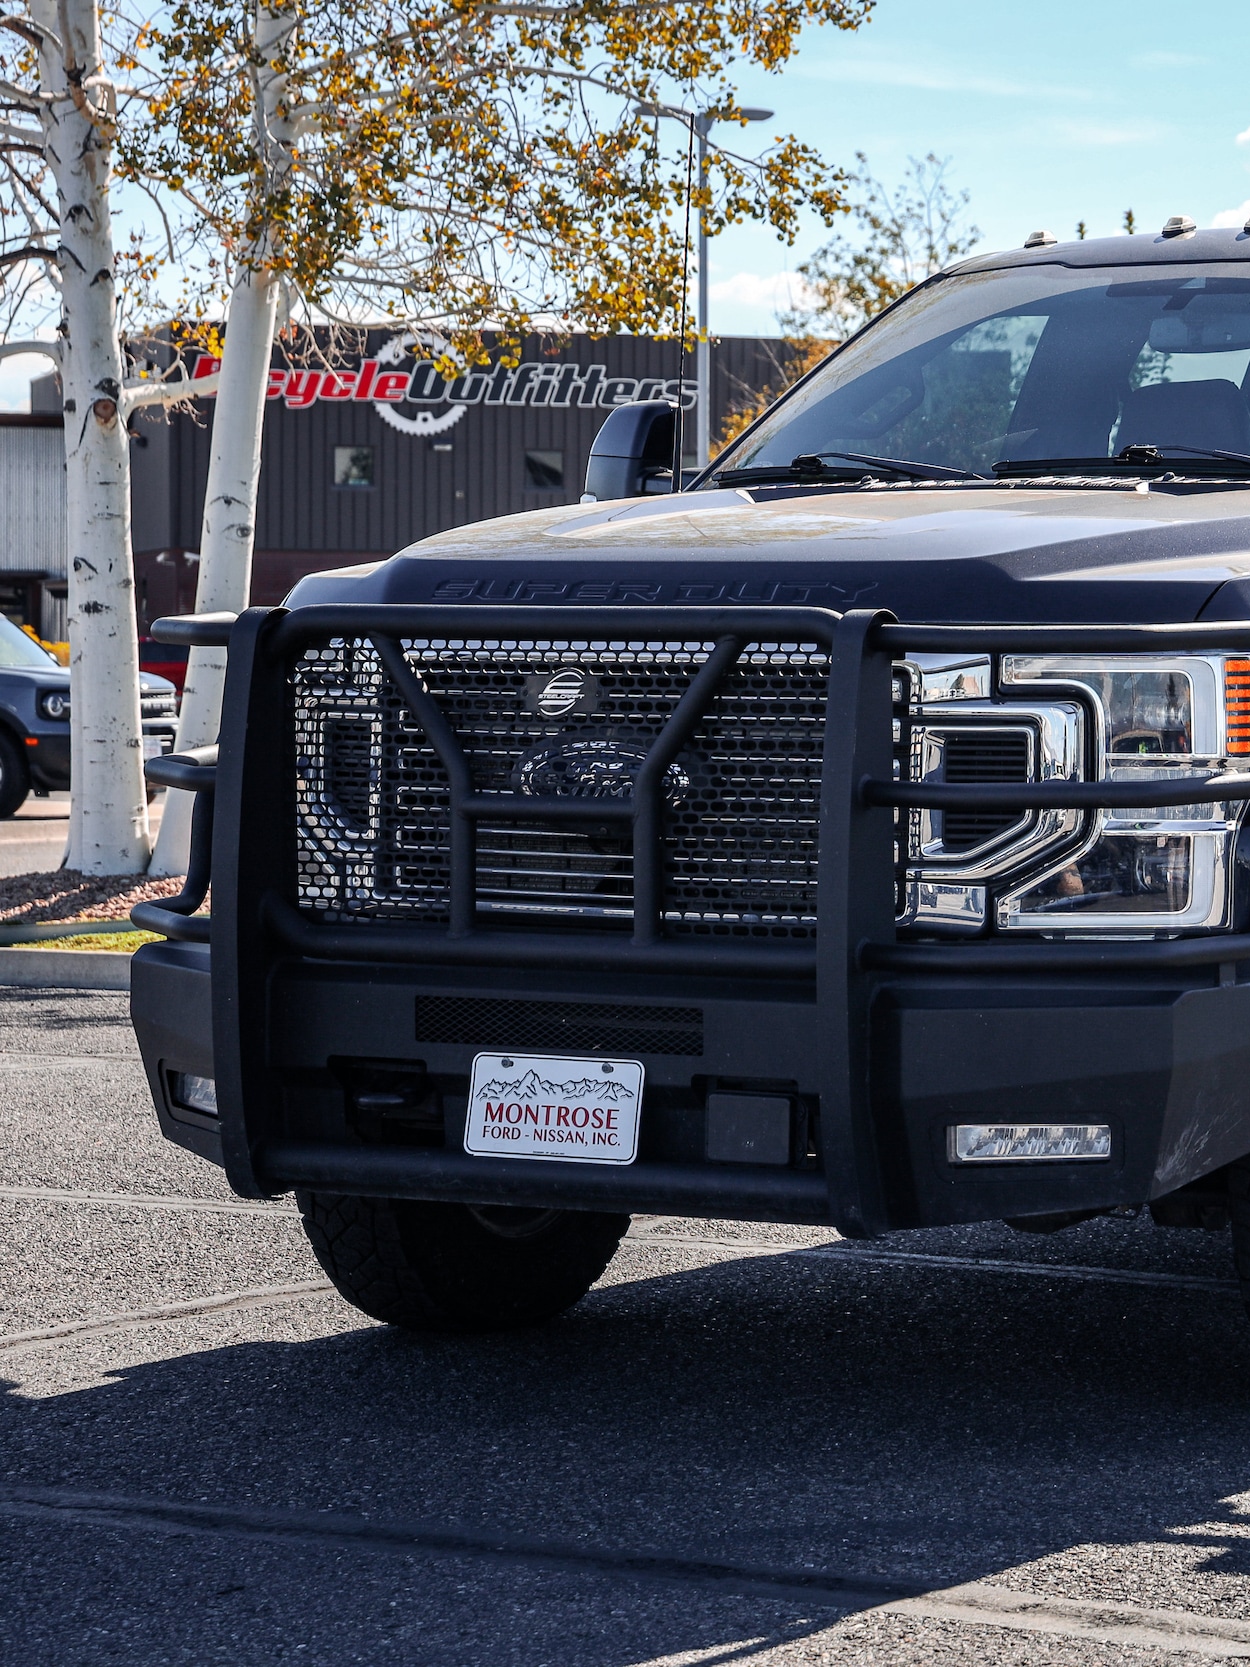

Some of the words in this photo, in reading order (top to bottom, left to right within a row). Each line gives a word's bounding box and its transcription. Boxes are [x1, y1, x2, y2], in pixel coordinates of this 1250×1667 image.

[406, 360, 698, 409] Outfitters
[432, 579, 662, 601] SUPER
[677, 581, 879, 602] DUTY
[484, 1102, 620, 1130] MONTROSE
[482, 1125, 521, 1140] FORD
[533, 1128, 588, 1147] NISSAN,
[592, 1132, 621, 1147] INC.
